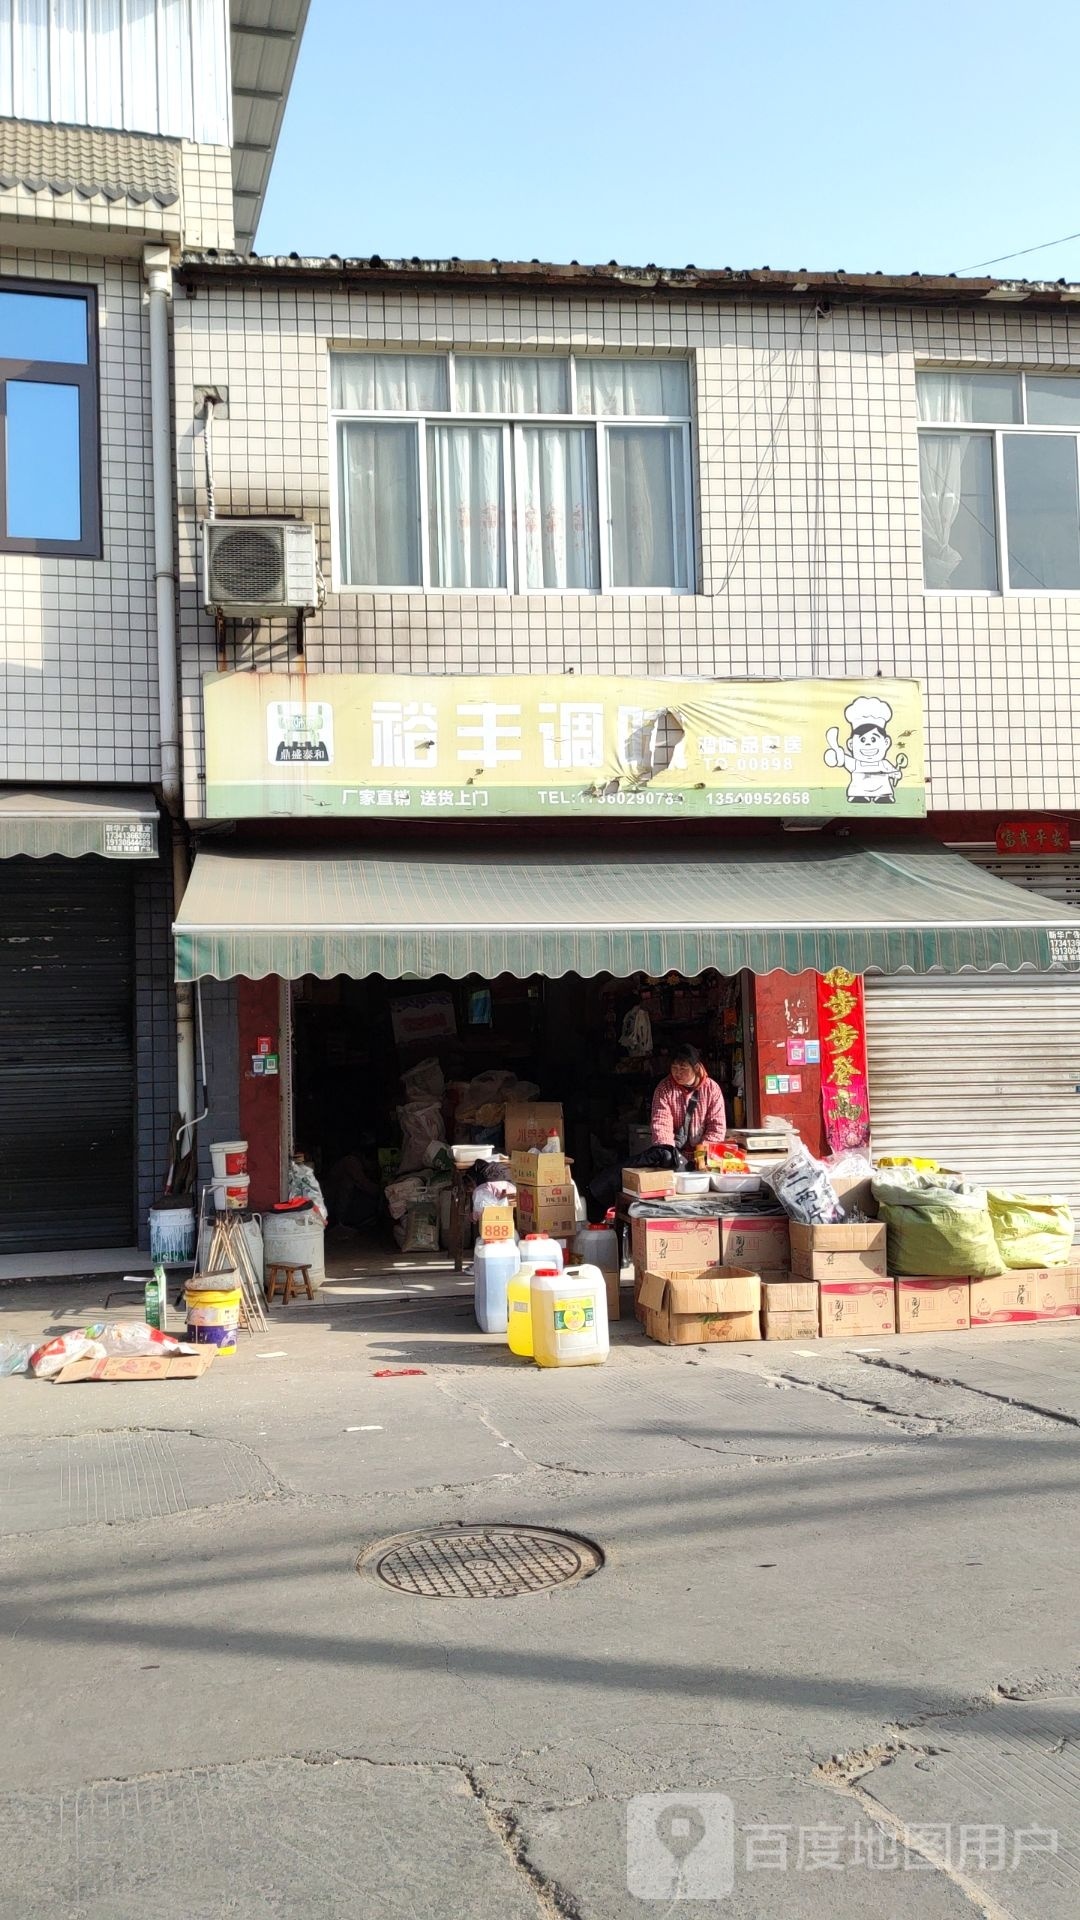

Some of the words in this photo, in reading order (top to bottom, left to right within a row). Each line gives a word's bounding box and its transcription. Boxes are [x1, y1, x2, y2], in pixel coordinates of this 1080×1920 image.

[280, 748, 325, 760] 鼎盛泰和
[341, 789, 411, 806] 厂家直销
[420, 790, 489, 806] 送货上门
[706, 792, 810, 805] 13540952658
[484, 1225, 508, 1236] 888
